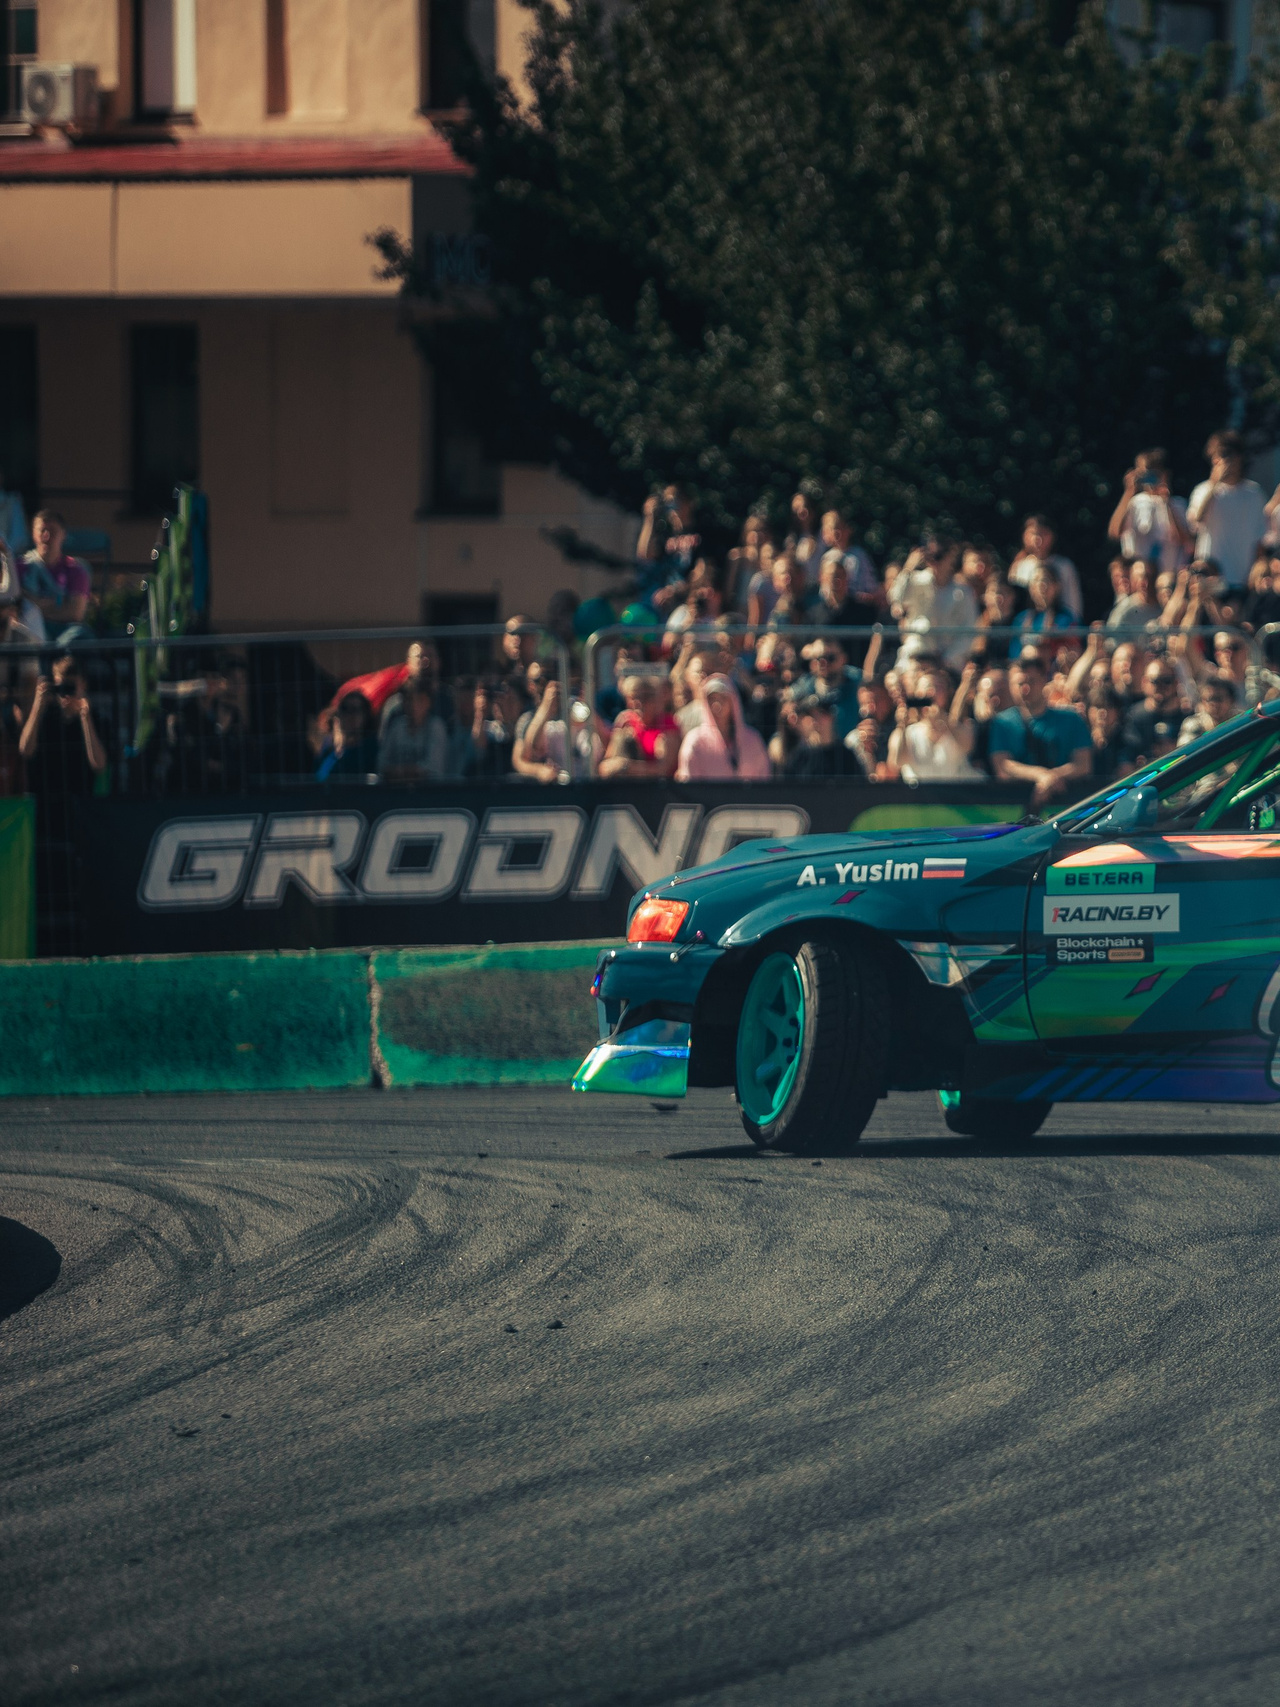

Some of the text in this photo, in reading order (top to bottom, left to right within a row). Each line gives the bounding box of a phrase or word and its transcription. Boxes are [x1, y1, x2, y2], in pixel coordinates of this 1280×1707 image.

[797, 860, 919, 886] A. Yusim
[1052, 905, 1170, 923] RACING.BY
[1057, 937, 1135, 949] Blockchain
[1057, 950, 1106, 962] Sports
